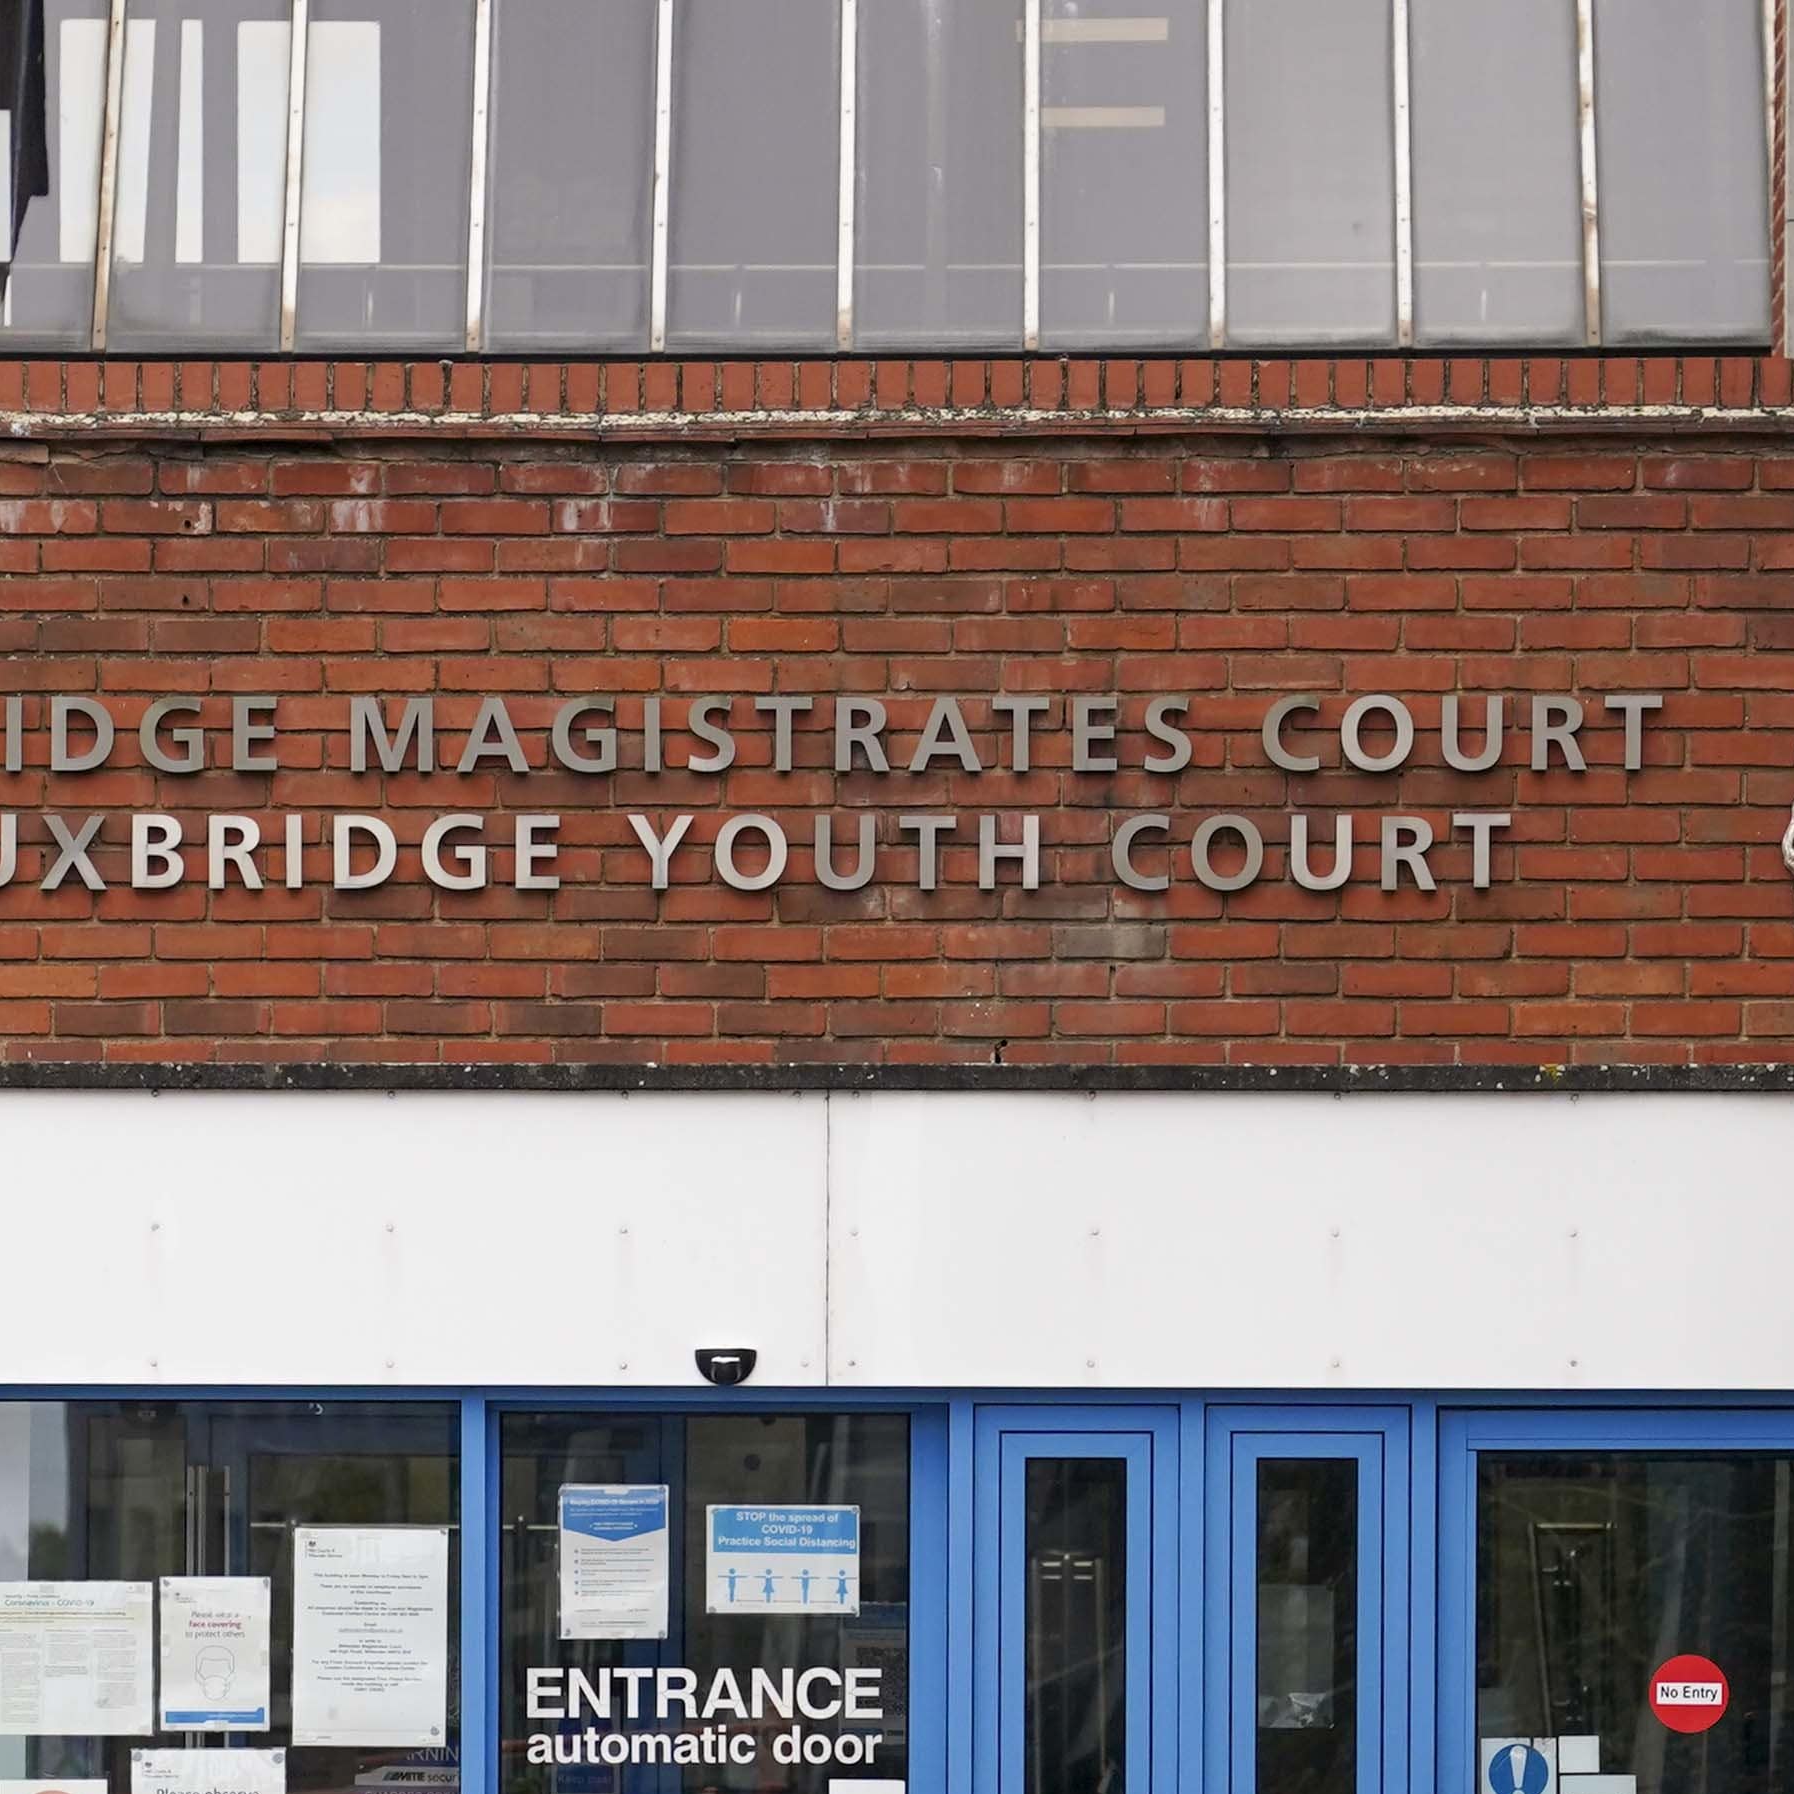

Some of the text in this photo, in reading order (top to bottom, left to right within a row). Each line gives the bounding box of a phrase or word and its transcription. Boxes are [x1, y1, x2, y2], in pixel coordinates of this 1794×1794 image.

[349, 694, 1193, 774] MAGISTRATES
[1261, 693, 1663, 773] COURT
[626, 812, 1040, 891] YOUTH
[1110, 811, 1512, 892] COURT
[735, 1511, 839, 1525] STOP the spread of
[761, 1524, 814, 1535] COVID-19
[717, 1536, 856, 1550] Practice Social Distancing
[525, 1666, 884, 1719] ENTRANCE
[1660, 1686, 1719, 1702] No Entry
[526, 1724, 883, 1765] automatic door
